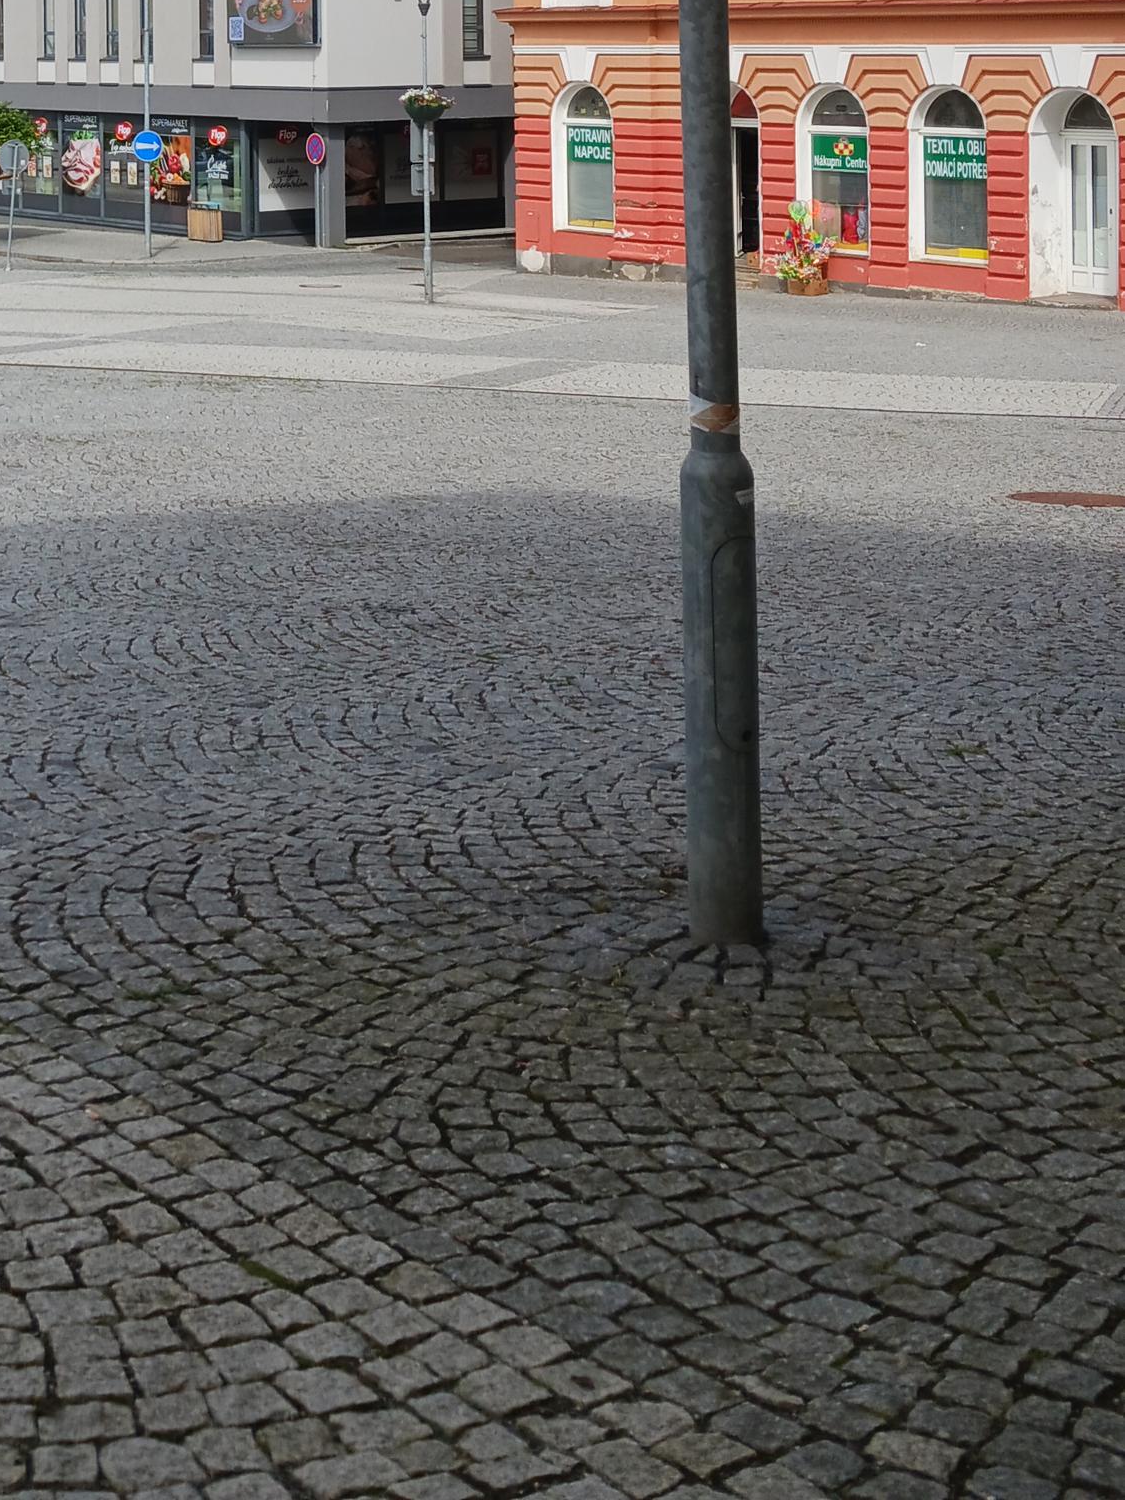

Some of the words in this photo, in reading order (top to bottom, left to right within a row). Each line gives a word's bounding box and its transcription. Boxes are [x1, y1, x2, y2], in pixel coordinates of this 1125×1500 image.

[64, 115, 97, 124] SUPERMARKET
[151, 118, 188, 128] SUPERMARKET
[211, 129, 226, 144] Flop
[278, 129, 297, 141] Flop
[574, 145, 612, 160] NAPOJE
[926, 138, 956, 155] TEXTIL
[958, 140, 965, 155] A
[813, 155, 842, 170] Nákupní
[925, 157, 956, 178] DOMÁCÍ
